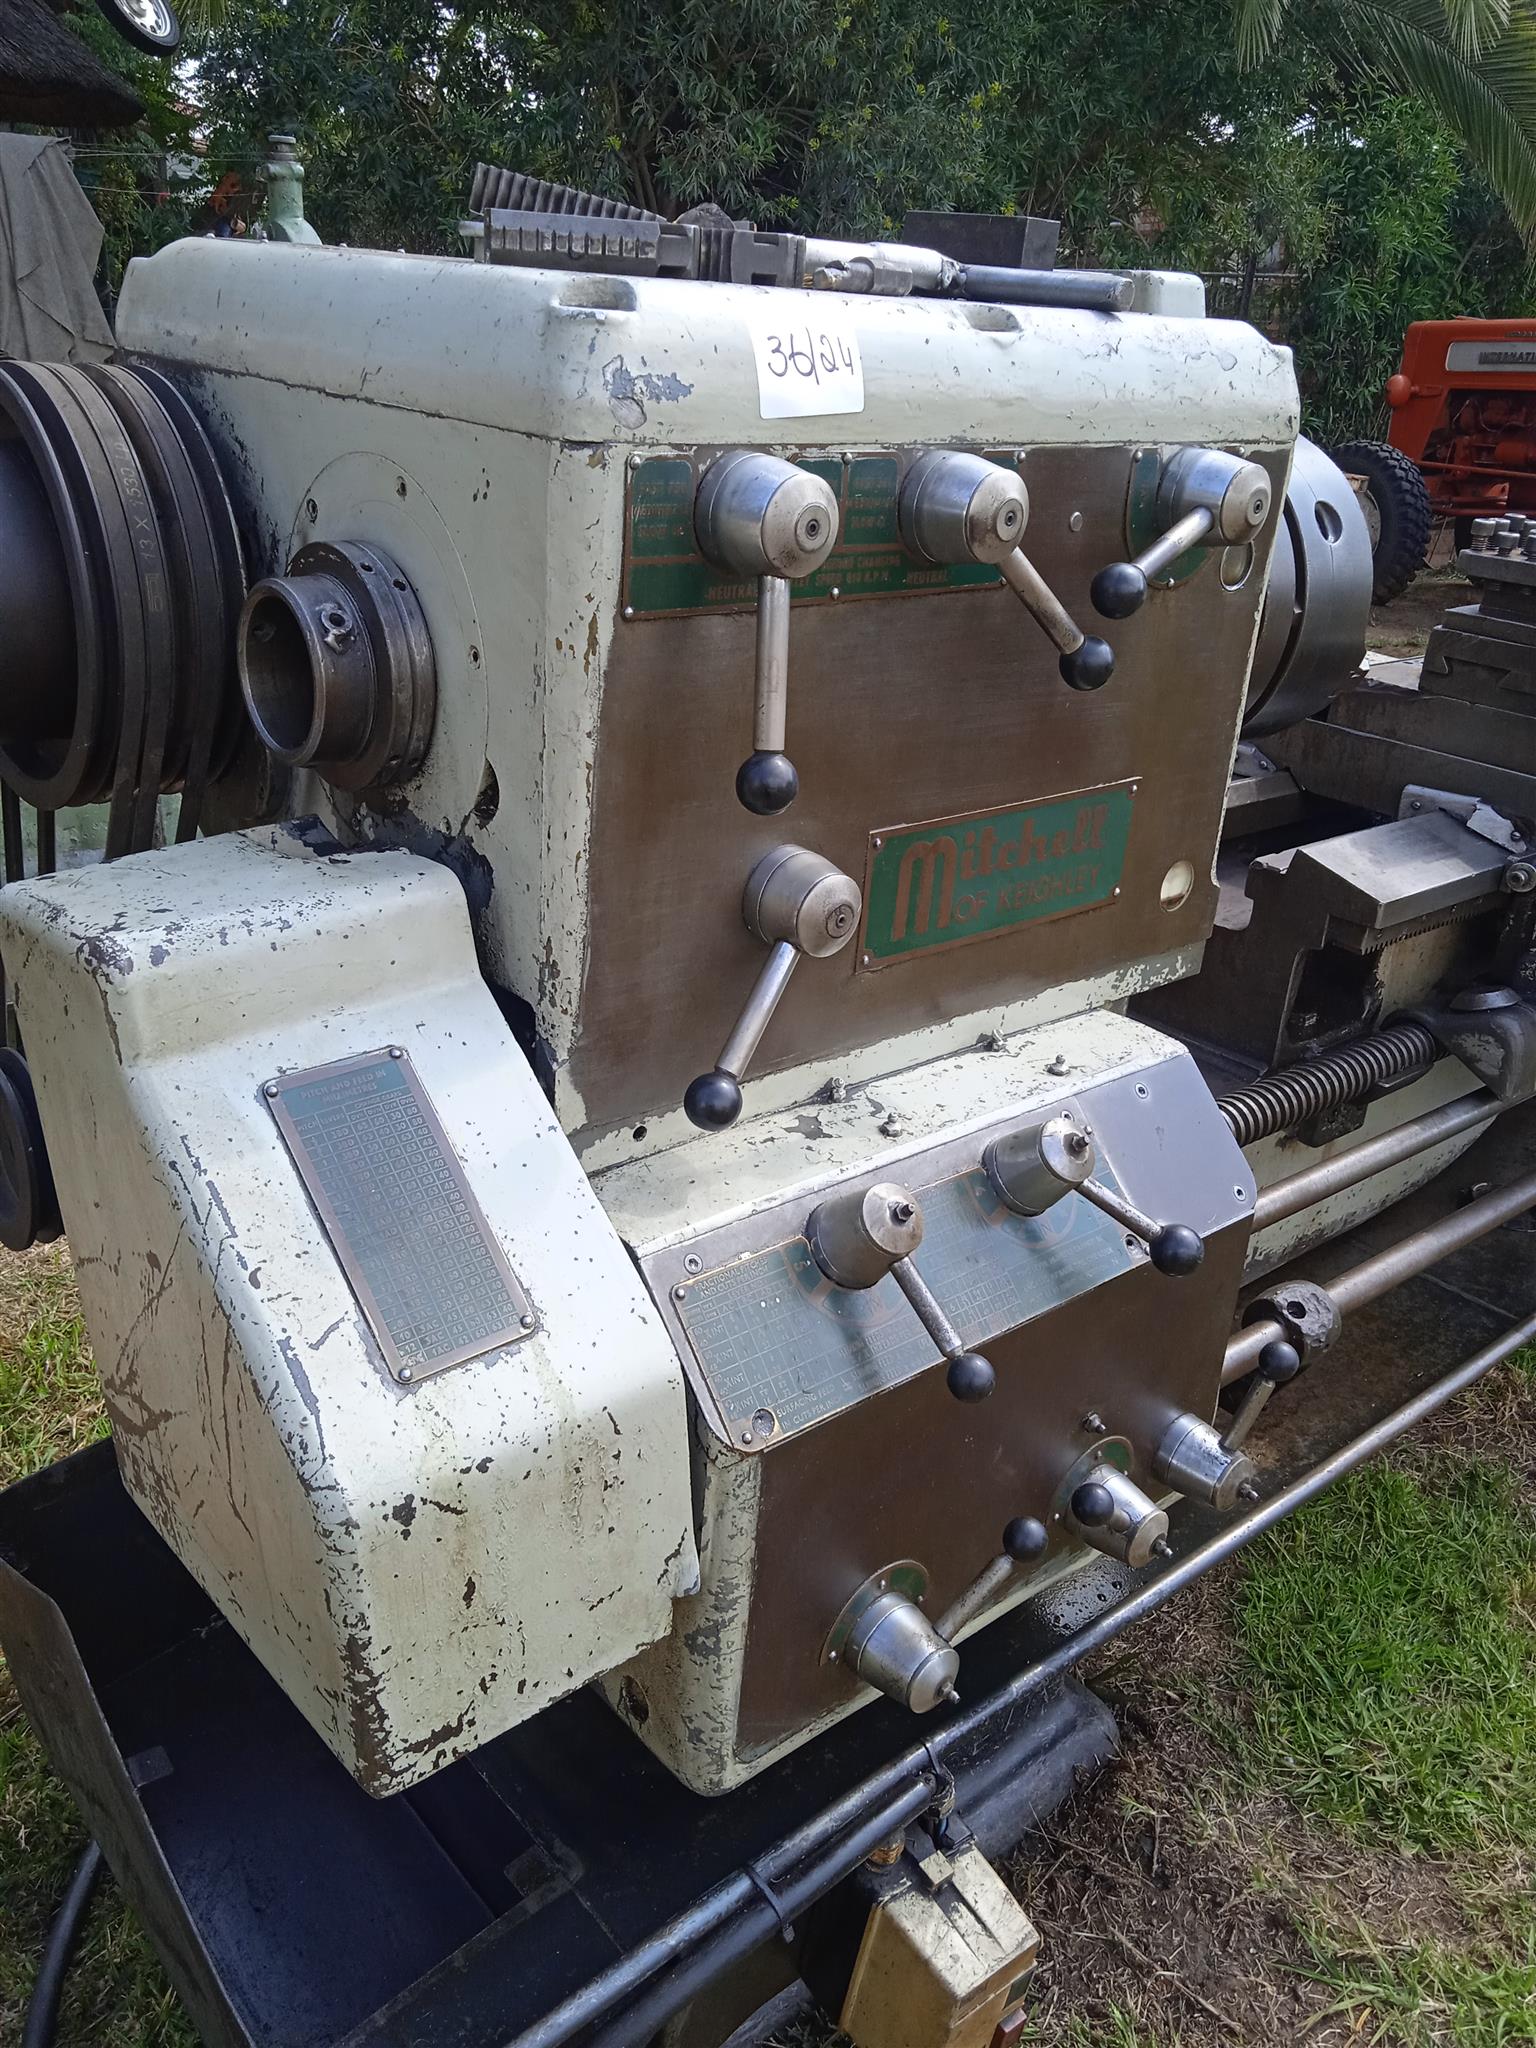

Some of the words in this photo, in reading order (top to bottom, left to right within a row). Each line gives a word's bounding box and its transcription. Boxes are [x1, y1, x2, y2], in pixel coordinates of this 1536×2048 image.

[767, 327, 854, 385] 36/24
[1479, 351, 1536, 364] INTERNATI
[891, 803, 1111, 942] Mitchell
[953, 890, 988, 922] OF
[995, 863, 1103, 914] KEIGHLEY
[300, 1085, 329, 1099] PITCH
[390, 1112, 402, 1121] 30
[417, 1128, 428, 1137] 40
[432, 1160, 444, 1169] 40
[421, 1175, 433, 1185] 63
[437, 1170, 449, 1179] 40
[447, 1192, 459, 1201] 40
[453, 1203, 464, 1212] 40
[458, 1214, 470, 1223] 40
[463, 1224, 475, 1234] 40
[468, 1275, 480, 1285] 63
[693, 1267, 740, 1291] FRACTIONAL
[699, 1286, 717, 1298] AND
[717, 1278, 736, 1291] CUTS
[749, 1265, 769, 1278] INCH
[439, 1299, 452, 1310] 30
[420, 1319, 439, 1332] 3AC
[425, 1330, 444, 1344] 3AC
[430, 1341, 450, 1355] 1AC
[775, 1392, 817, 1417] SURFACING
[792, 1409, 811, 1424] CUTS
[811, 1403, 825, 1415] PER
